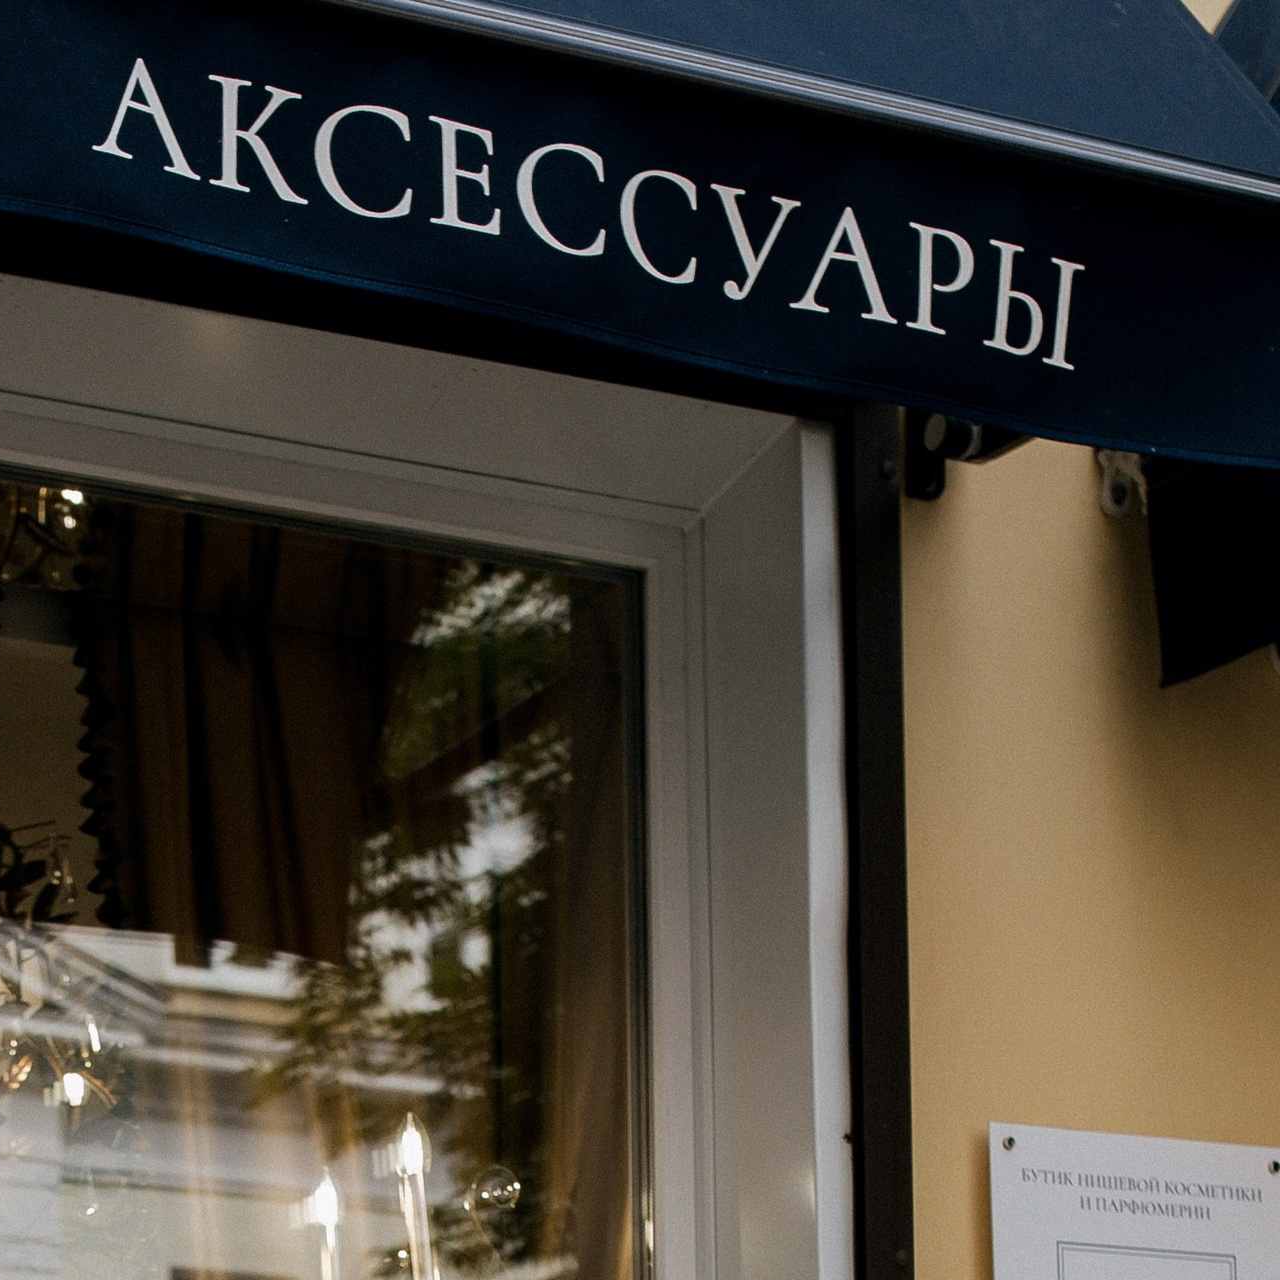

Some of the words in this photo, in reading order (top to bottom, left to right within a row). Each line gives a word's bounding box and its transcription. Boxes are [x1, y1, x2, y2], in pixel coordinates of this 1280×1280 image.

[91, 56, 1085, 371] АКСЕССУАРЫ
[1021, 1167, 1073, 1187] БУТИК
[1077, 1172, 1160, 1195] НИШЕВОЙ
[1164, 1179, 1263, 1203] КОСМЕТИКИ
[1079, 1196, 1092, 1211] И
[1096, 1196, 1211, 1220] ПАРФЮМЕРИИ
